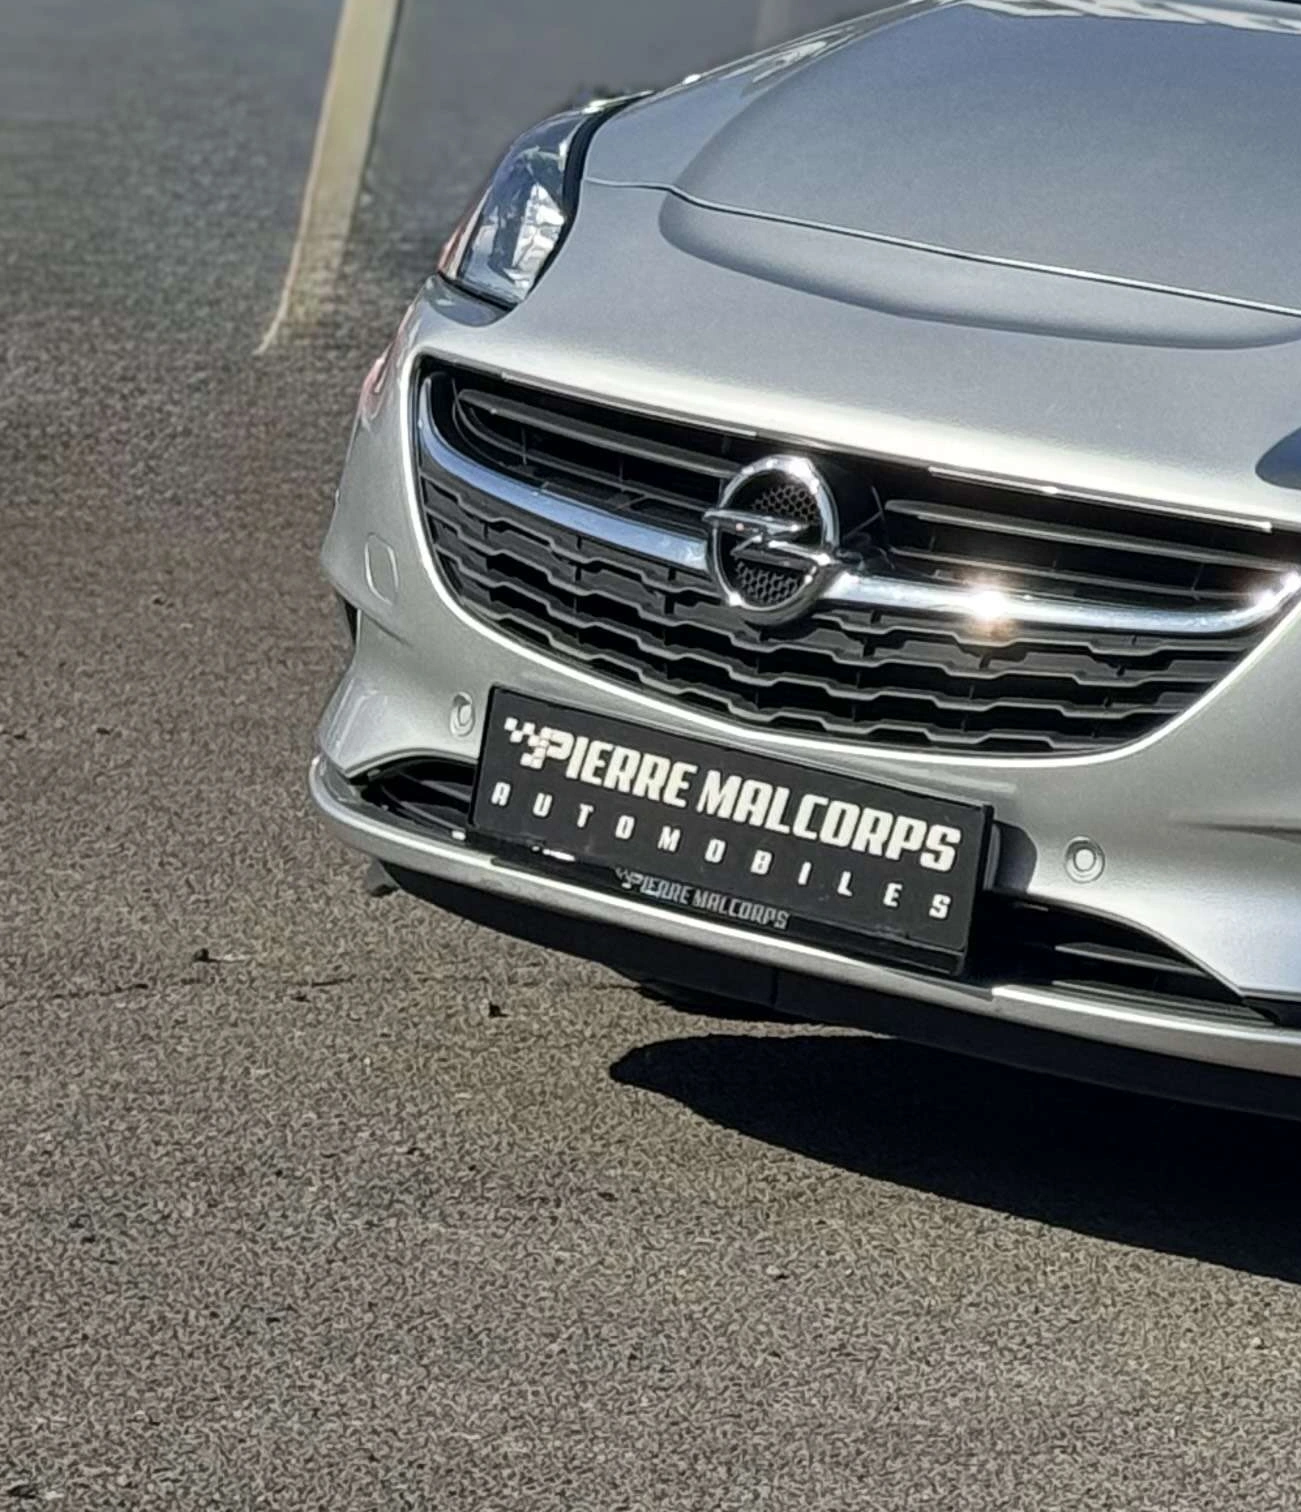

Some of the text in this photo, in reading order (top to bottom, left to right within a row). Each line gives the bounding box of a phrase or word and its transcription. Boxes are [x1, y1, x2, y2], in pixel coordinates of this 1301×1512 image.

[490, 781, 951, 920] AUTOMOBILES
[519, 724, 962, 873] PIERRE MALCORPS
[620, 870, 791, 931] PIERRE MALCORPS
